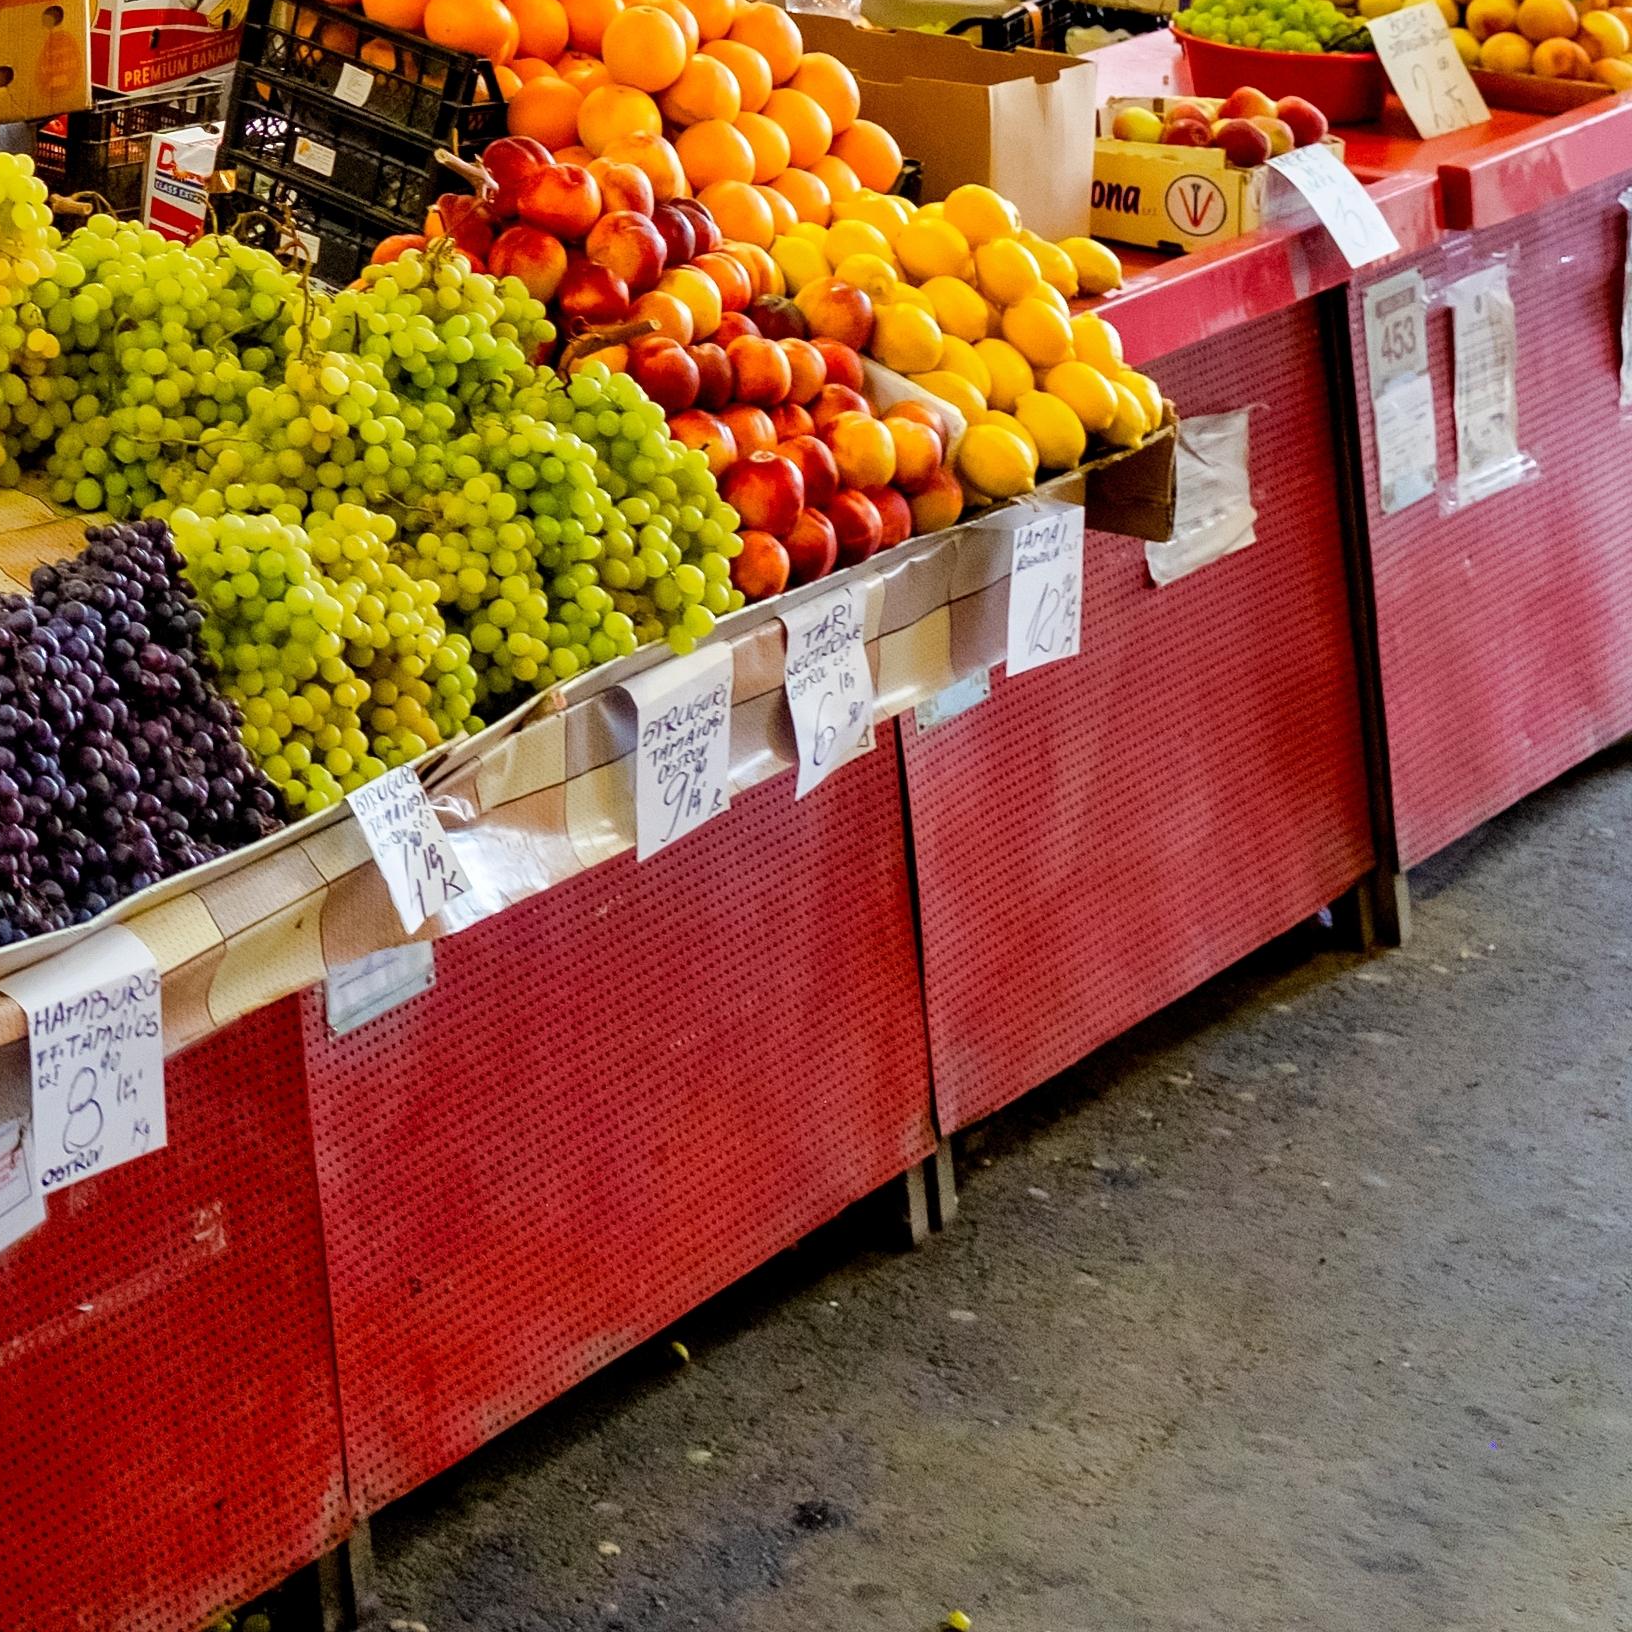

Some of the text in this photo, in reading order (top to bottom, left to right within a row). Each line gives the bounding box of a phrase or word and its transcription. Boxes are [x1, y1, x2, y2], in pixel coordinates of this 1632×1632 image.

[124, 56, 189, 88] PREMIUM
[153, 177, 179, 197] CLASS
[1380, 317, 1417, 363] 453
[802, 603, 853, 649] TARI
[659, 770, 690, 843] 9
[34, 969, 161, 1036] HAMBURG
[62, 1066, 105, 1155] 8
